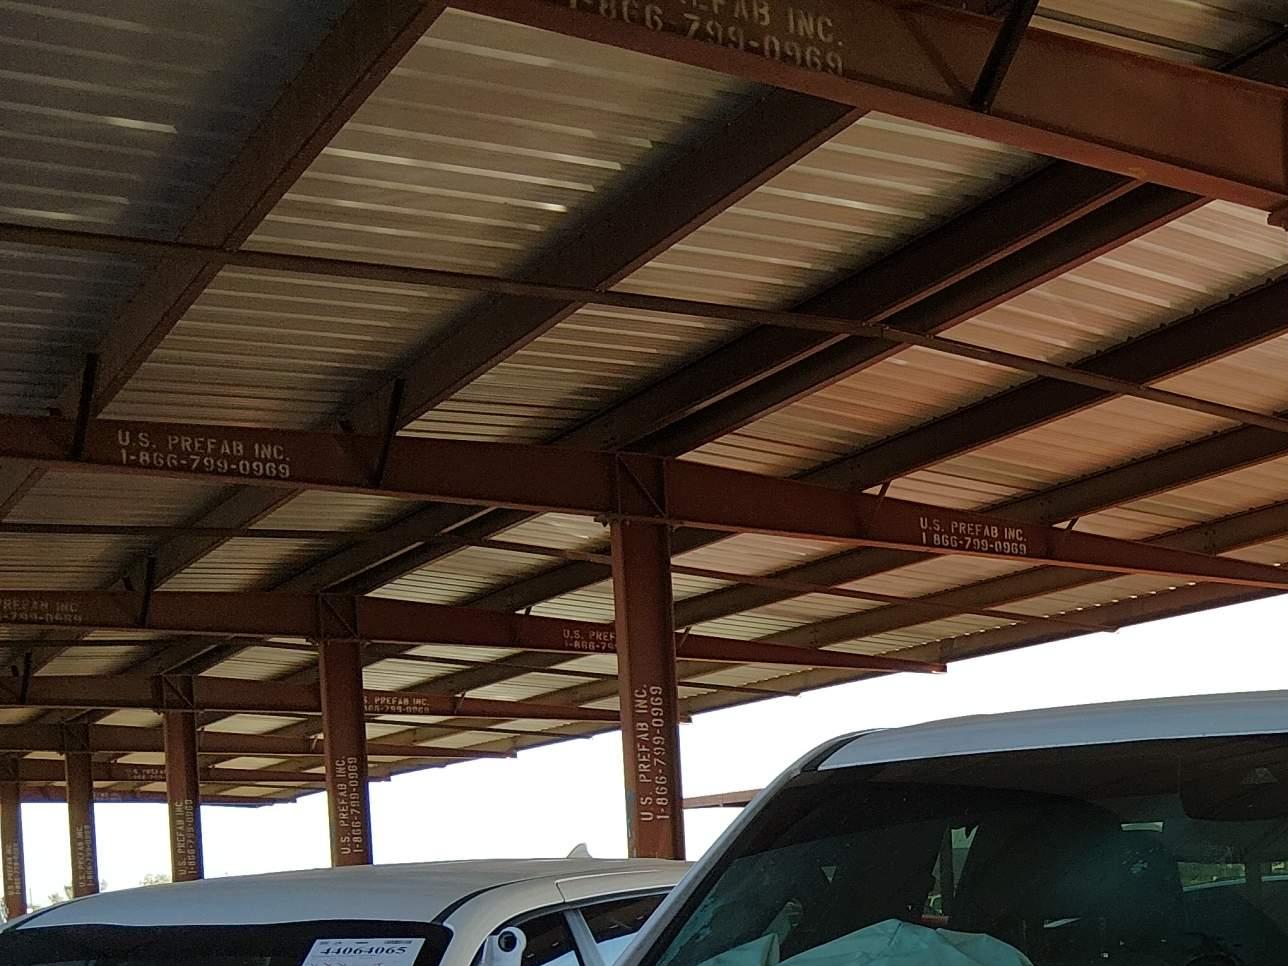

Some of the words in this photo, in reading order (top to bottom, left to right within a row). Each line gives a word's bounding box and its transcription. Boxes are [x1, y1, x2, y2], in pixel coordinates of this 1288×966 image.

[787, 7, 843, 46] INC.
[118, 429, 157, 449] U.S.
[168, 435, 244, 457] PREFAB
[254, 442, 291, 462] INC.
[120, 448, 291, 479] 1-866-799-0969
[920, 516, 945, 532] U.S.
[951, 521, 999, 538] PREFAB
[1004, 528, 1027, 542] INC.
[634, 684, 648, 713] INC.
[636, 722, 652, 783] PREFAB
[649, 685, 670, 820] 1-866-799-0969
[336, 783, 349, 827] PREFAB
[640, 790, 654, 821] U.S.
[340, 832, 352, 855] U.S.
[320, 946, 408, 956] 44064065
